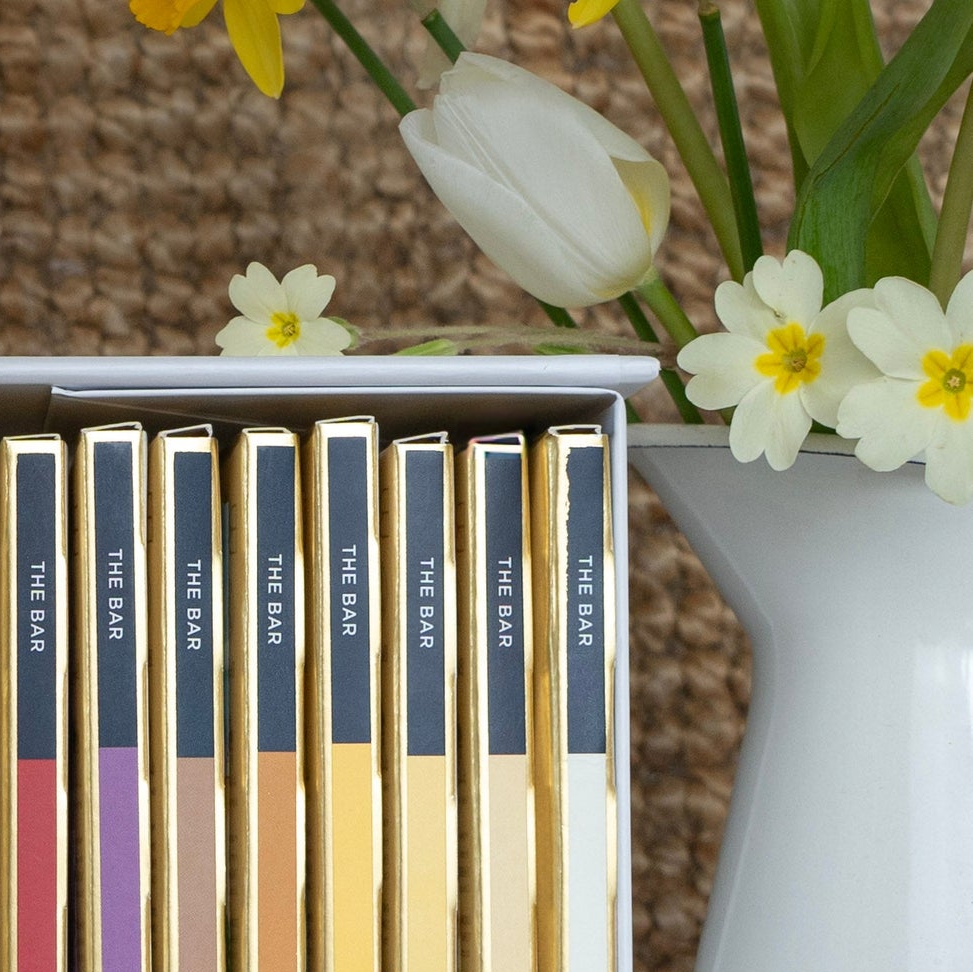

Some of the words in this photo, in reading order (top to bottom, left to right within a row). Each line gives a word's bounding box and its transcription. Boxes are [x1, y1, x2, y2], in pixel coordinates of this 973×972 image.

[30, 560, 46, 602] THE
[108, 548, 123, 589] THE
[186, 559, 202, 600] THE
[267, 553, 283, 594] THE
[341, 544, 357, 585] THE
[419, 557, 435, 598] THE
[498, 556, 513, 597] THE
[578, 555, 593, 595] THE
[30, 609, 45, 652] BAR
[108, 597, 124, 640] BAR
[186, 607, 202, 650] BAR
[267, 602, 282, 645] BAR
[341, 593, 357, 636] BAR
[419, 606, 434, 648] BAR
[498, 605, 513, 648] BAR
[578, 603, 593, 646] BAR
